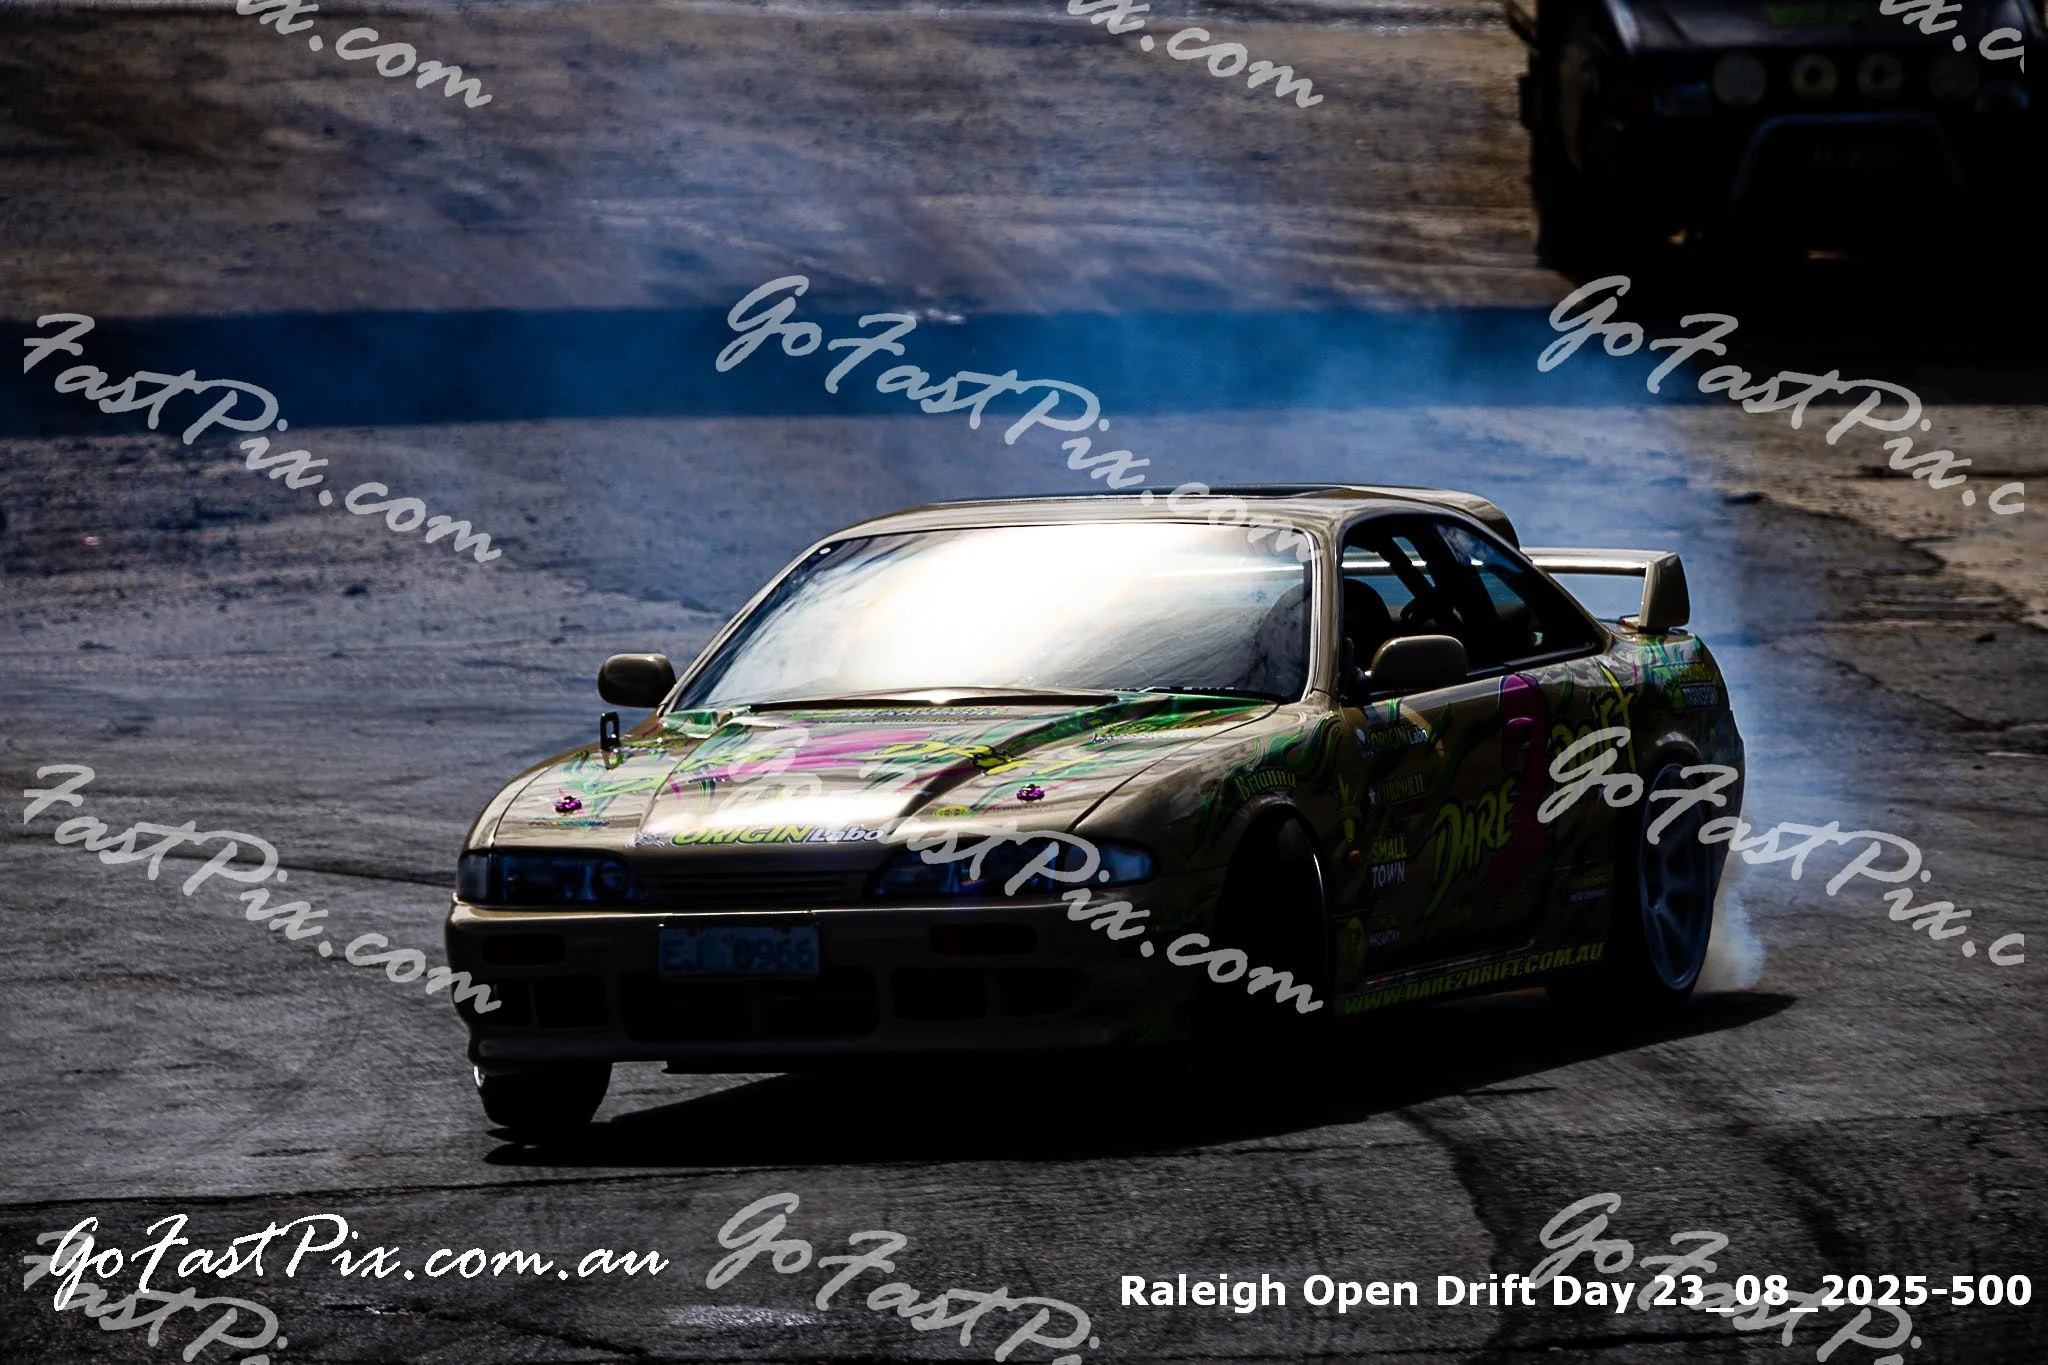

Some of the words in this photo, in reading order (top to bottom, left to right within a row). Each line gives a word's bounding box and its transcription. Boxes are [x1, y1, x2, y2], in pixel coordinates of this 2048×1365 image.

[673, 825, 809, 845] ORIGIN
[807, 827, 885, 842] Labo
[1372, 835, 1407, 864] SMALL
[1371, 860, 1406, 888] TOWN
